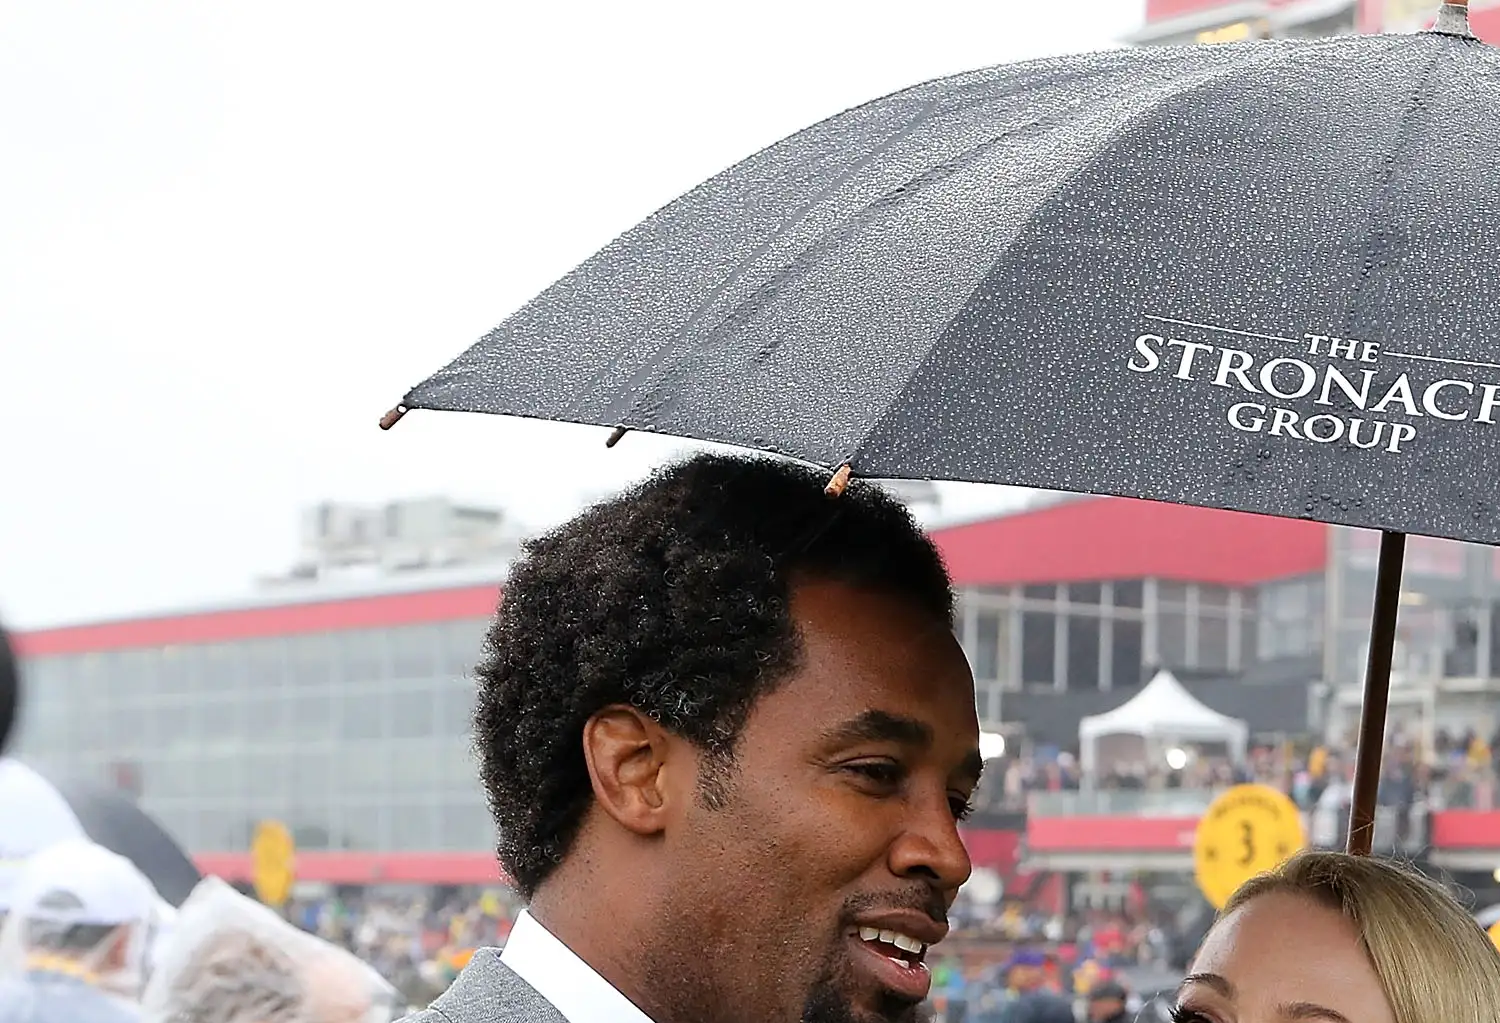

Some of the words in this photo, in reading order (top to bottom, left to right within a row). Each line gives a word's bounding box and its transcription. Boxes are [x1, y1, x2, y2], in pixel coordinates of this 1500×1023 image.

[1303, 332, 1381, 364] THE
[1226, 401, 1418, 454] GROUP
[1236, 820, 1256, 866] 3
